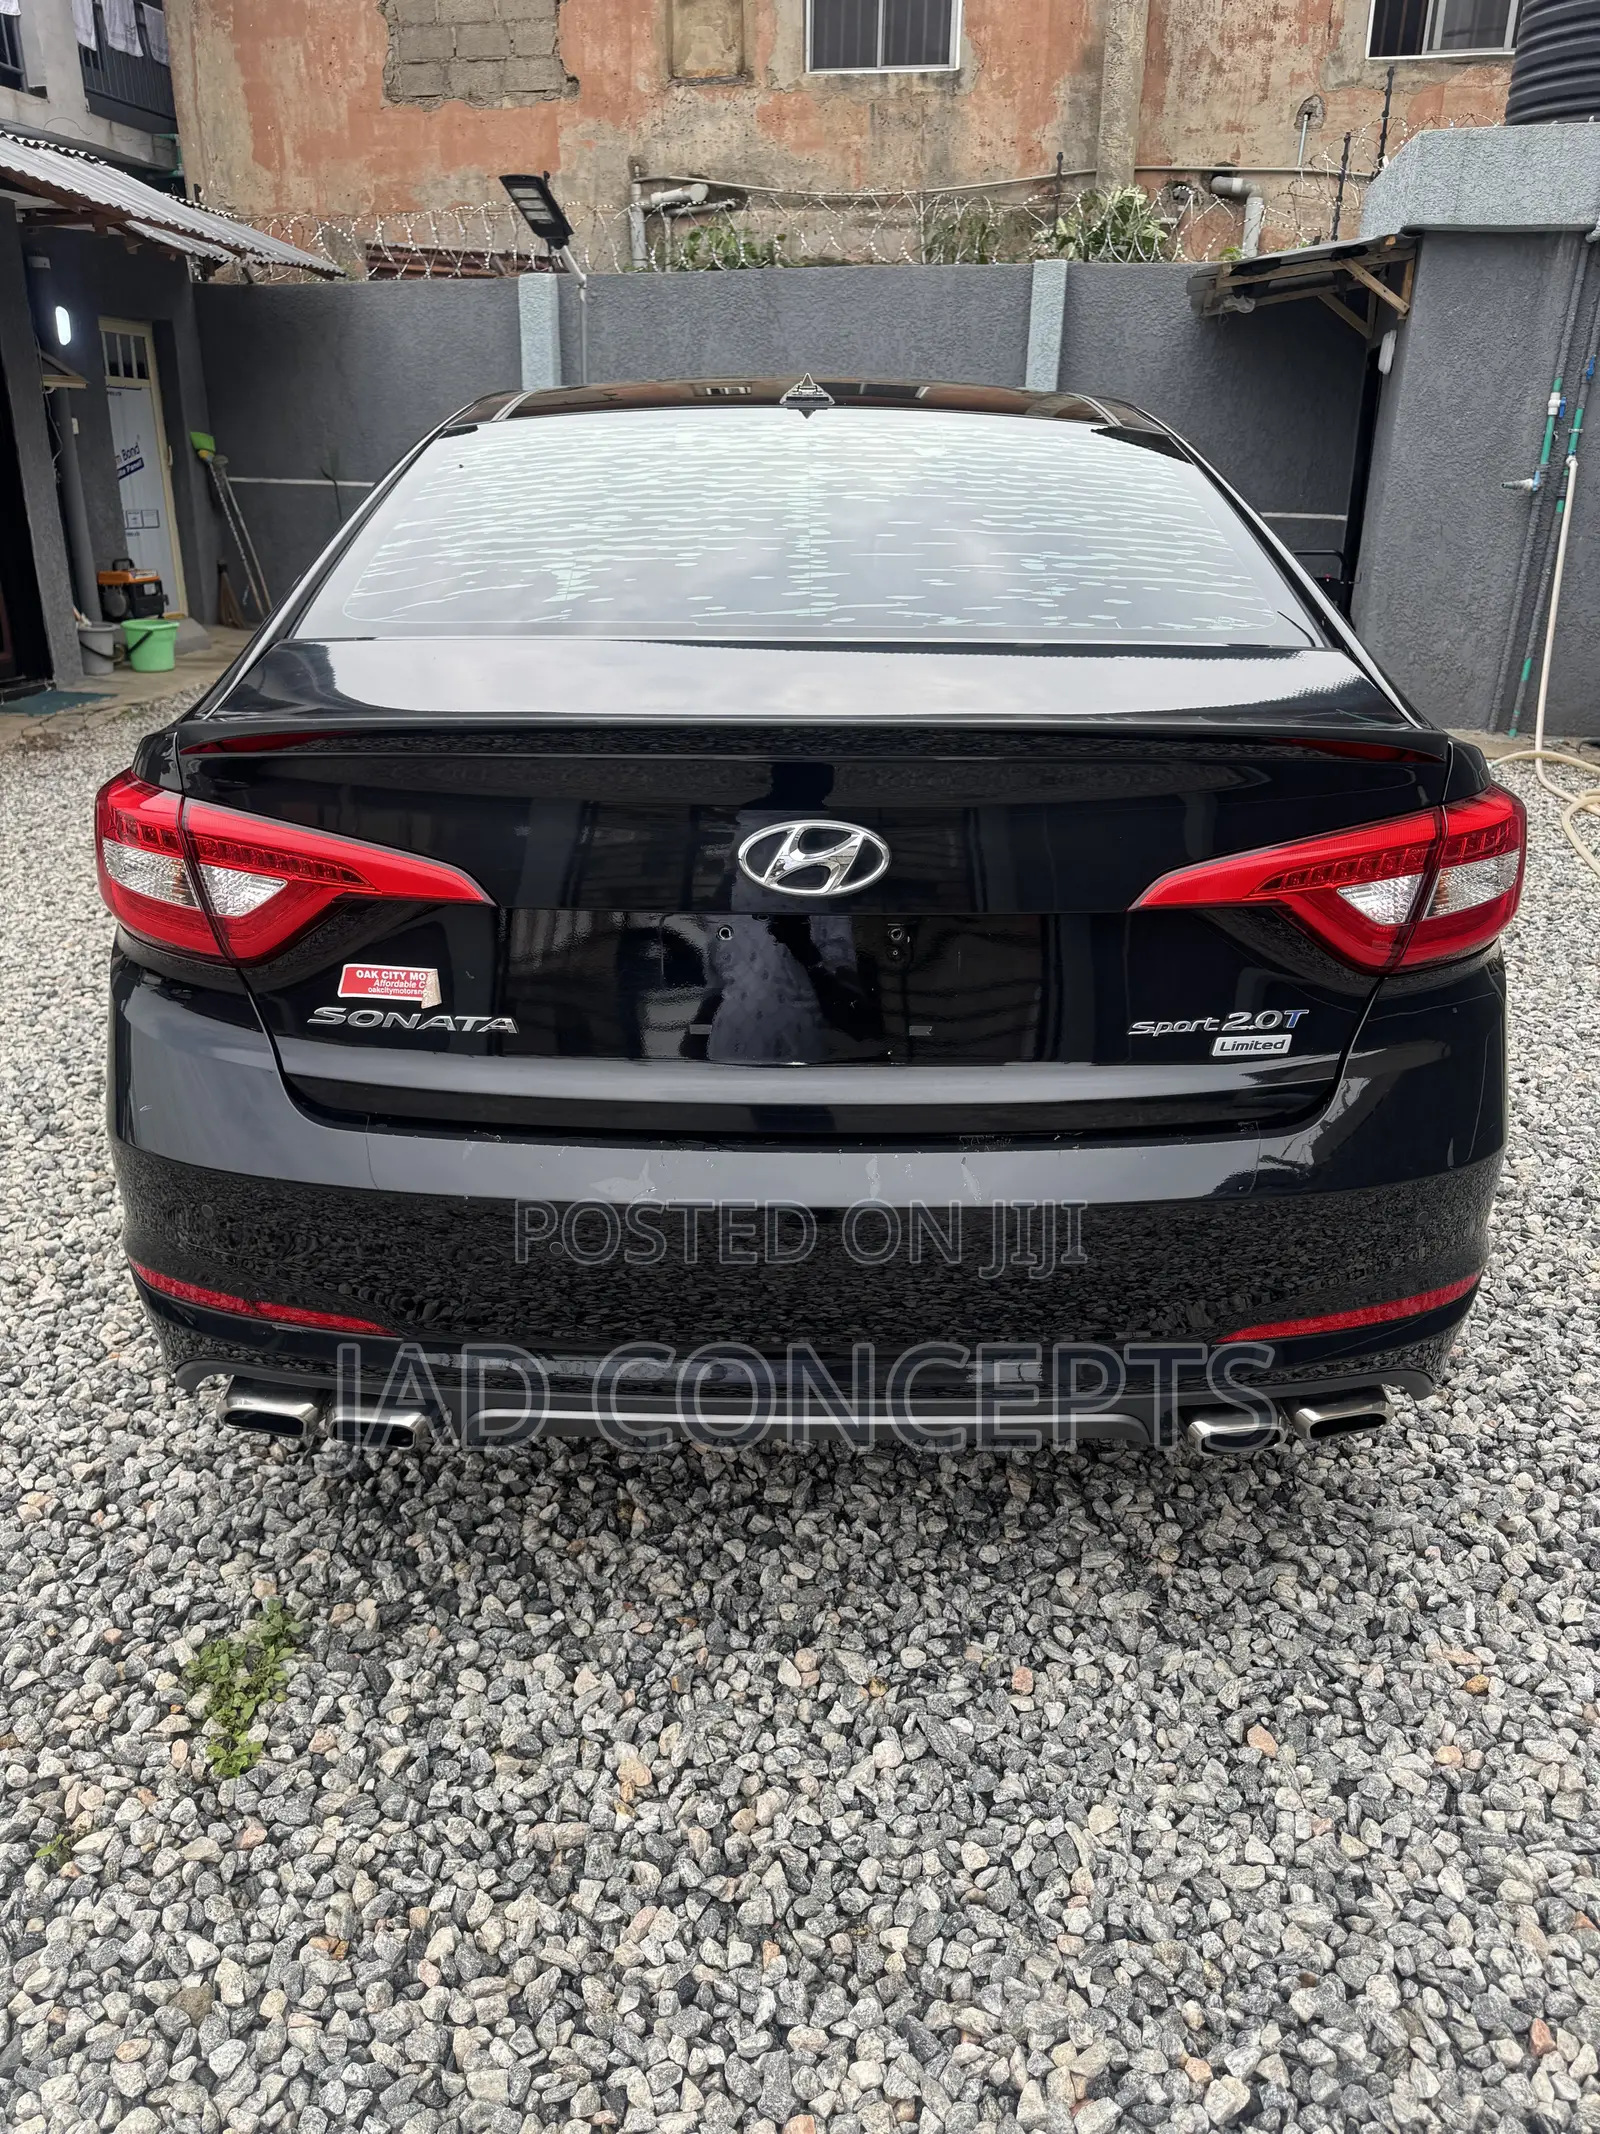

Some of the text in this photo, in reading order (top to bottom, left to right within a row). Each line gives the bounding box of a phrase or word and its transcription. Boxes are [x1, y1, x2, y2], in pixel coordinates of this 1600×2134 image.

[356, 970, 427, 981] OAK CITY MO
[373, 979, 426, 989] Affordable C
[307, 1006, 518, 1034] SONATA
[1221, 1009, 1310, 1031] 2.0T
[1219, 1039, 1286, 1052] Limited
